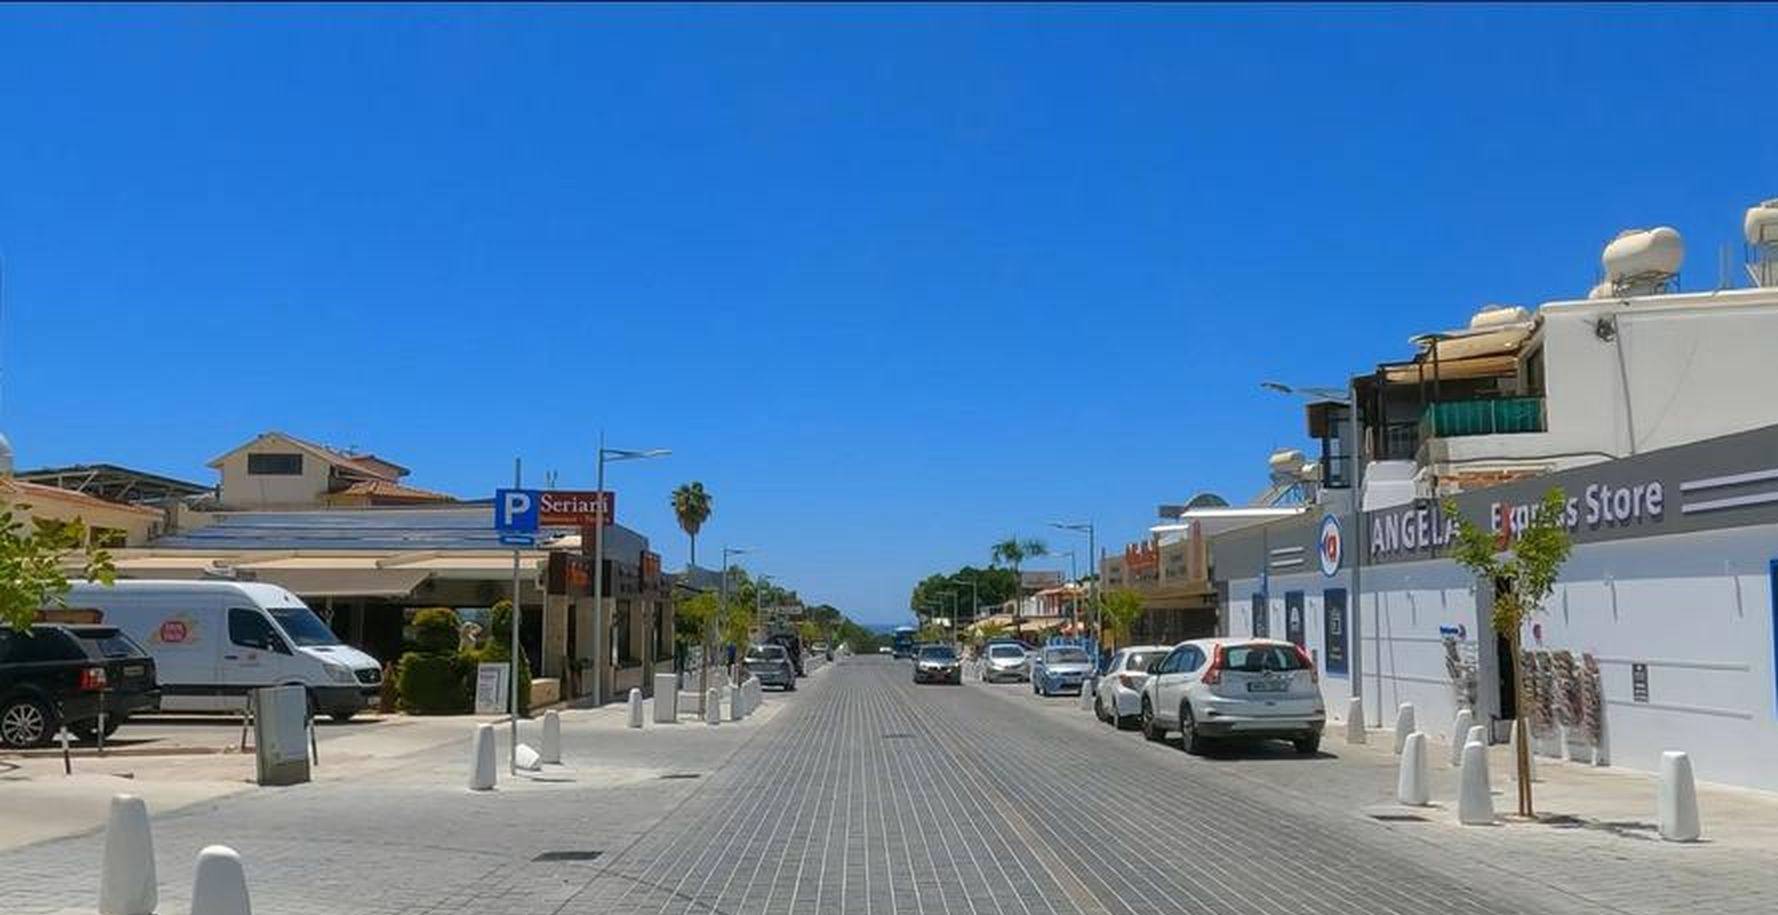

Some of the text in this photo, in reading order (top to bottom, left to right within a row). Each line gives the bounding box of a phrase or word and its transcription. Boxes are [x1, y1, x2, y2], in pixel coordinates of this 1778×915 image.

[506, 493, 530, 525] P
[1491, 497, 1578, 545] Exprs
[1586, 480, 1663, 524] Store
